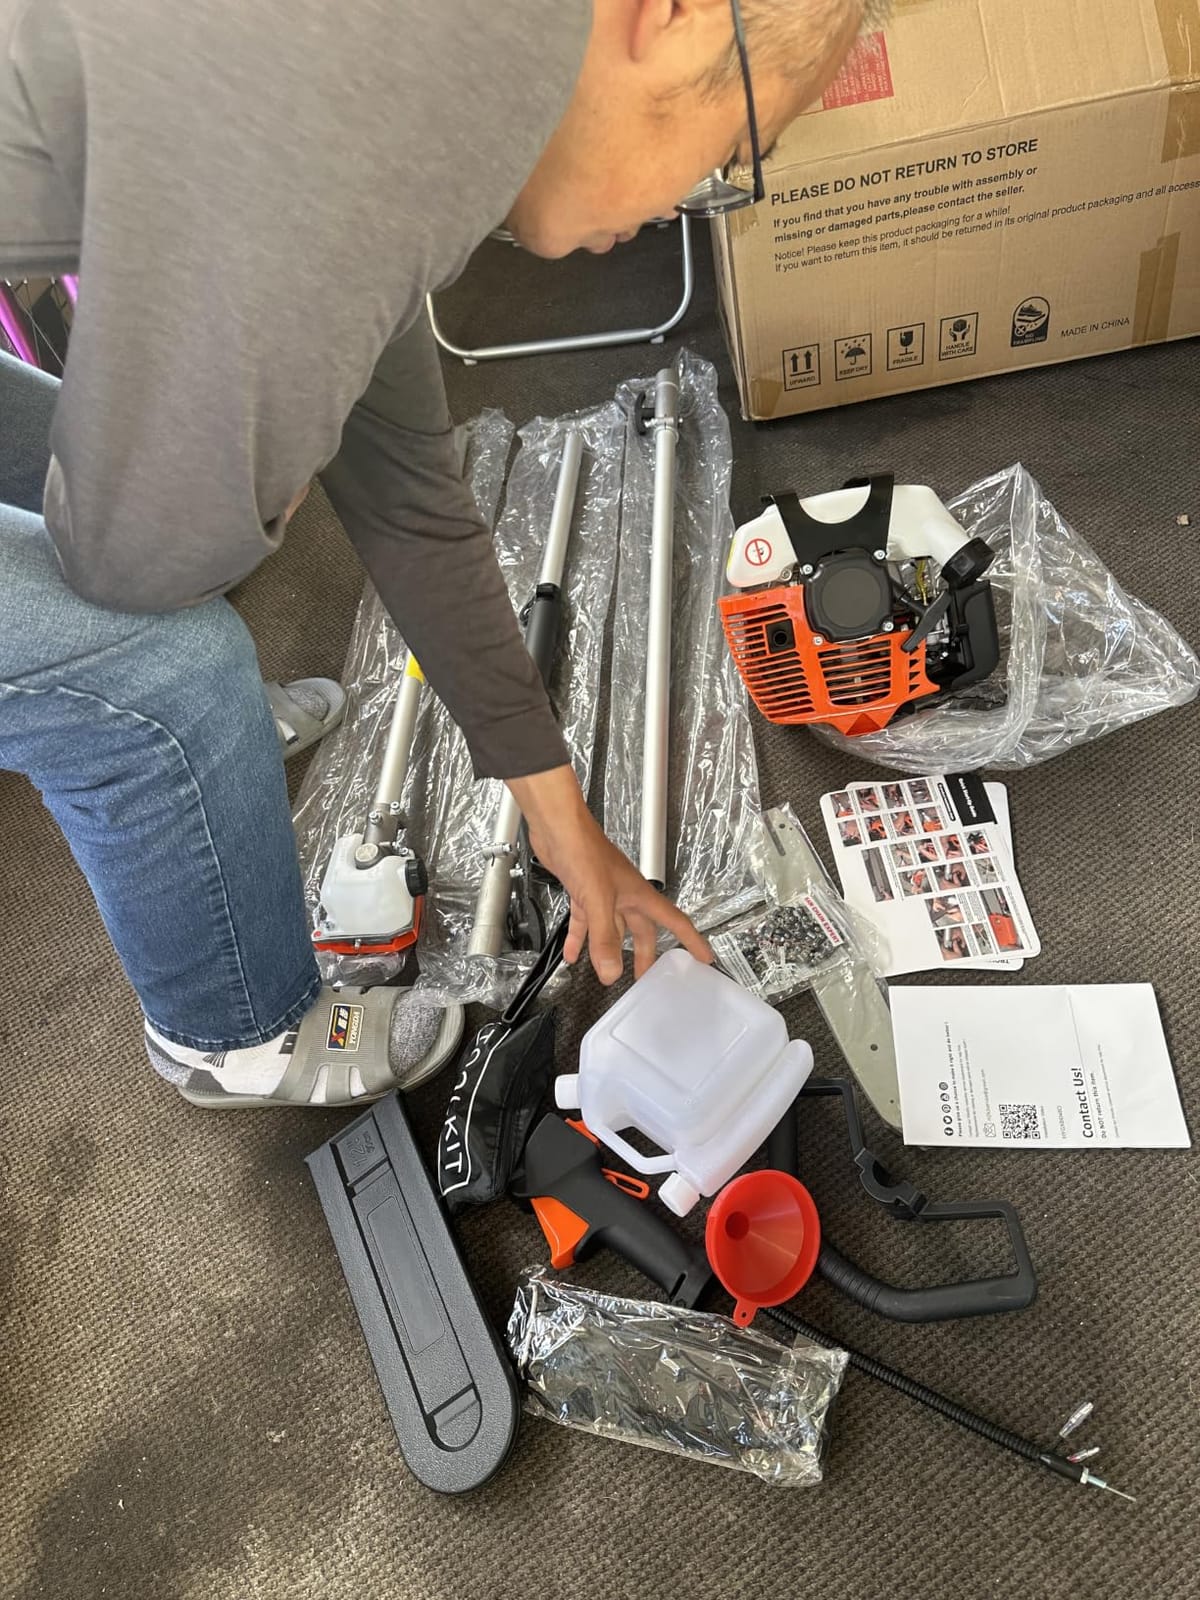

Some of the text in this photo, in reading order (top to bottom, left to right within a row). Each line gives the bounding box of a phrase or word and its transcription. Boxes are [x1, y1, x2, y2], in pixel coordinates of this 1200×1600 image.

[771, 139, 1038, 206] PLEASE DO NOT RETURN TO STORE
[773, 166, 1038, 228] If you find that you have any trouble with assembly or
[774, 184, 1024, 243] missing or damaged parts,please contact the seller.
[774, 250, 804, 262] Notice!
[807, 244, 837, 254] Please
[838, 238, 860, 248] keep
[862, 234, 878, 244] this
[880, 226, 913, 241] product
[915, 217, 960, 234] packaging
[962, 214, 975, 223] for
[984, 205, 1010, 218] while!
[775, 264, 782, 272] If
[783, 262, 799, 272] you
[800, 256, 822, 267] want
[824, 254, 833, 262] to
[834, 250, 860, 261] return
[862, 246, 878, 255] this
[879, 240, 901, 252] item,
[903, 238, 908, 246] it
[910, 230, 940, 245] should
[942, 229, 953, 238] be
[955, 221, 992, 236] returned
[994, 220, 1003, 228] in
[1004, 216, 1015, 225] its
[1017, 208, 1050, 224] original
[1052, 202, 1086, 218] product
[1088, 193, 1134, 210] packaging
[1136, 188, 1154, 200] and
[1155, 185, 1166, 195] all
[945, 342, 970, 350] HANDLE
[1060, 317, 1130, 338] MADE IN CHINA
[839, 364, 869, 376] KEEP DRY
[892, 356, 918, 365] FRAGILE
[789, 376, 816, 386] UPWARD
[812, 906, 825, 922] CHAIN
[824, 922, 840, 944] EXPERT
[349, 1011, 360, 1044] YONGDA
[1070, 1068, 1094, 1138] Contact Us!
